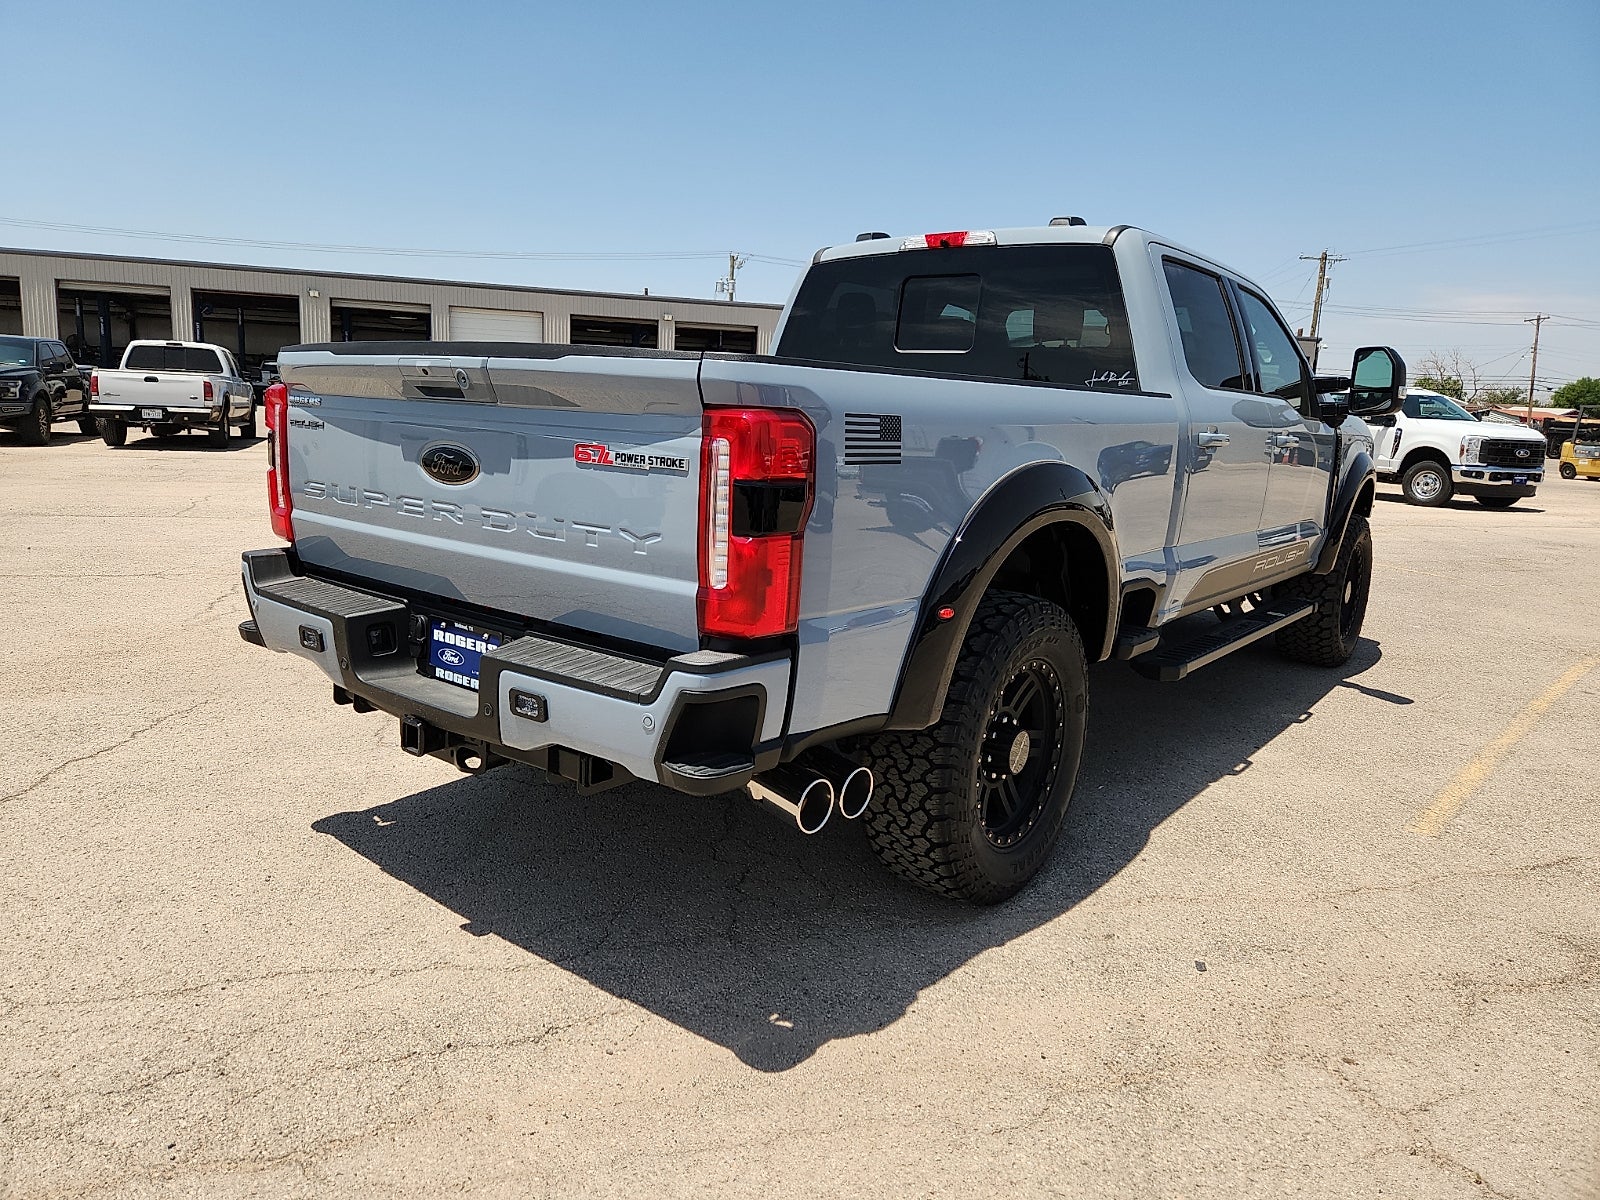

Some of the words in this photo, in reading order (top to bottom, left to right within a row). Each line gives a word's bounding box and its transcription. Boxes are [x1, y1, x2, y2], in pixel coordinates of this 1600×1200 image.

[431, 452, 462, 476] Ford
[575, 443, 614, 465] 6.7L
[615, 452, 646, 465] POWER
[647, 455, 686, 470] STROKE
[303, 480, 465, 526] SUPER
[481, 507, 663, 556] DUTY
[1253, 547, 1307, 573] ROUSH
[442, 649, 461, 664] Ford
